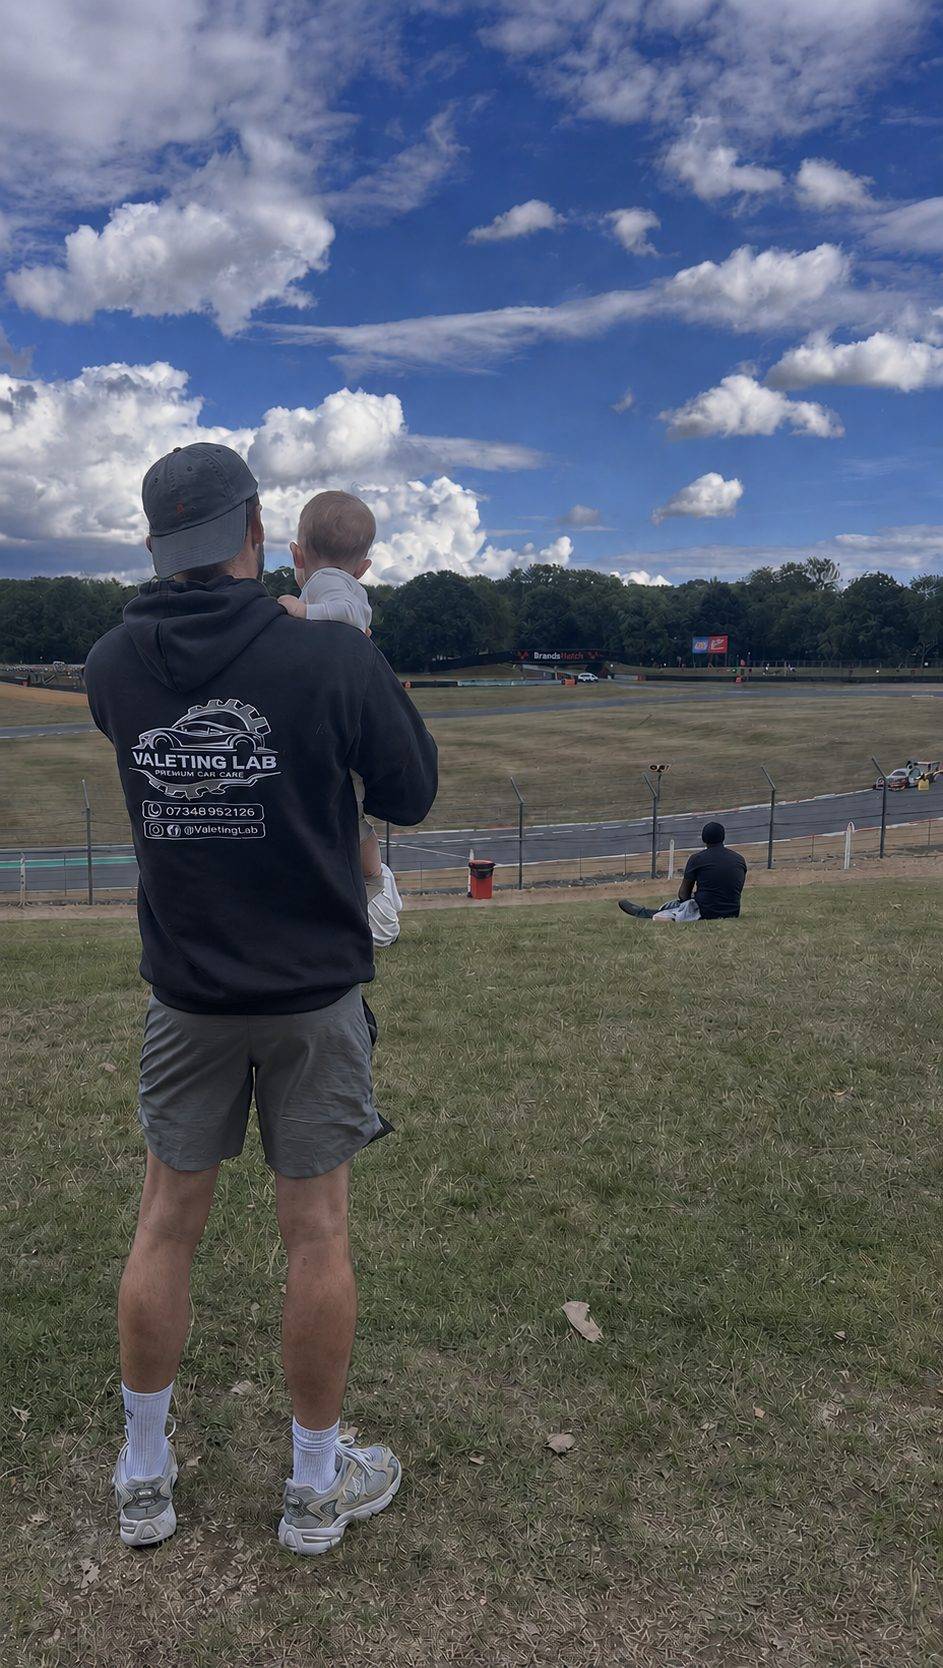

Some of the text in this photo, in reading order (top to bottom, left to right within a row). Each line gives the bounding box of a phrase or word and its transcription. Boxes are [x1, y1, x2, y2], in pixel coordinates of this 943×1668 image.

[132, 751, 277, 770] VALETING LAB
[155, 769, 195, 777] PREMIUM
